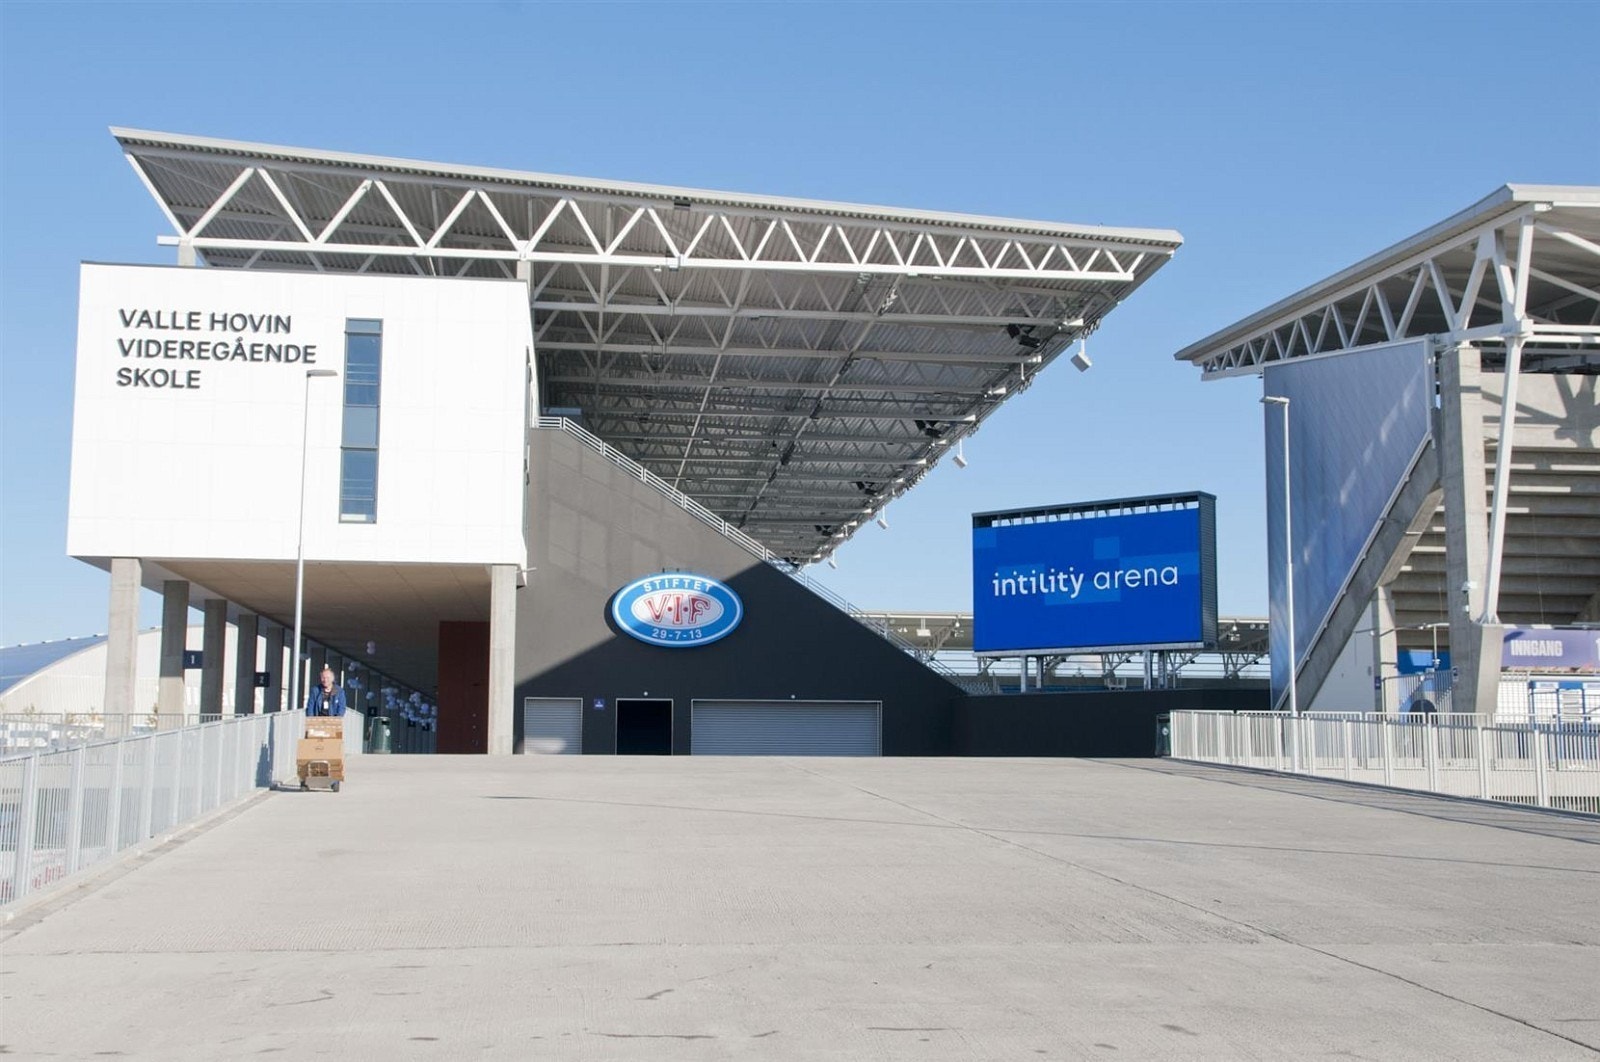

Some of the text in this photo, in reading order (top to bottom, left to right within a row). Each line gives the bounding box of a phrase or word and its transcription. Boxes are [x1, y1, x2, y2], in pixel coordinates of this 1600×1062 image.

[118, 308, 291, 334] VALLE HOVIN
[116, 336, 317, 364] VIDEREGÅENDE
[115, 367, 201, 389] SKOLE
[644, 578, 712, 592] STIFTET
[992, 566, 1178, 599] intility arena
[652, 628, 702, 639] 29-7-13
[1510, 639, 1563, 657] INNGANG
